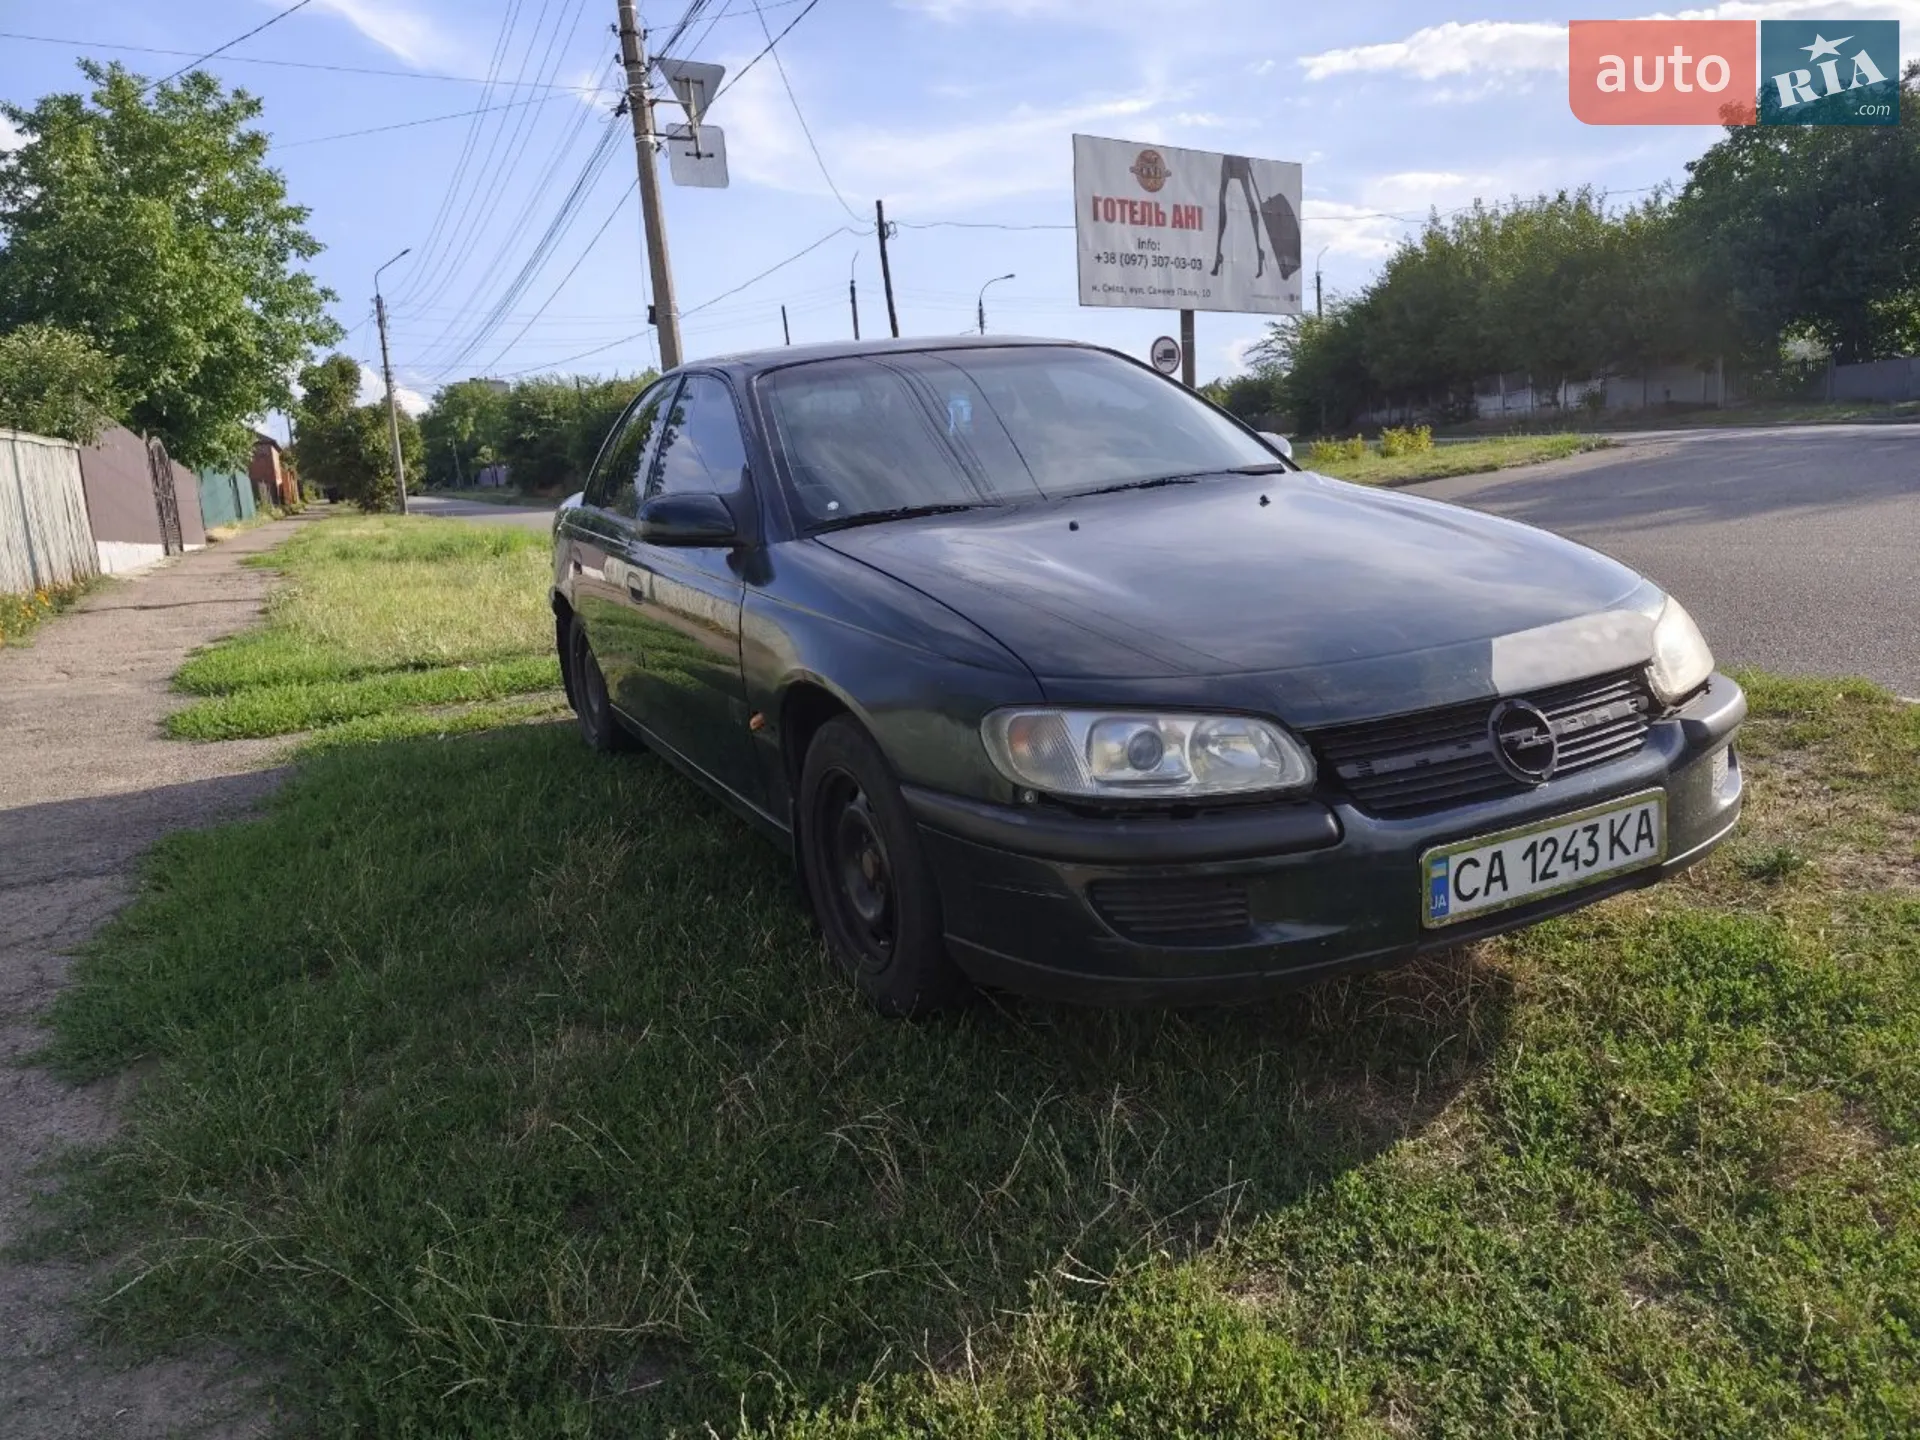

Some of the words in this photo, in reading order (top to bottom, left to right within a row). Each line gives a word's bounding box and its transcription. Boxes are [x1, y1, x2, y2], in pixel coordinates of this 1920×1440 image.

[1092, 196, 1167, 227] ГОТЕЛЬ
[1171, 203, 1204, 232] АНІ
[1094, 251, 1117, 265] +38
[1119, 252, 1148, 270] (097)
[1151, 255, 1203, 271] 307-03-03
[1202, 288, 1212, 298] 10
[1454, 849, 1509, 902] CA
[1521, 823, 1600, 884] 1243
[1608, 808, 1655, 861] KA
